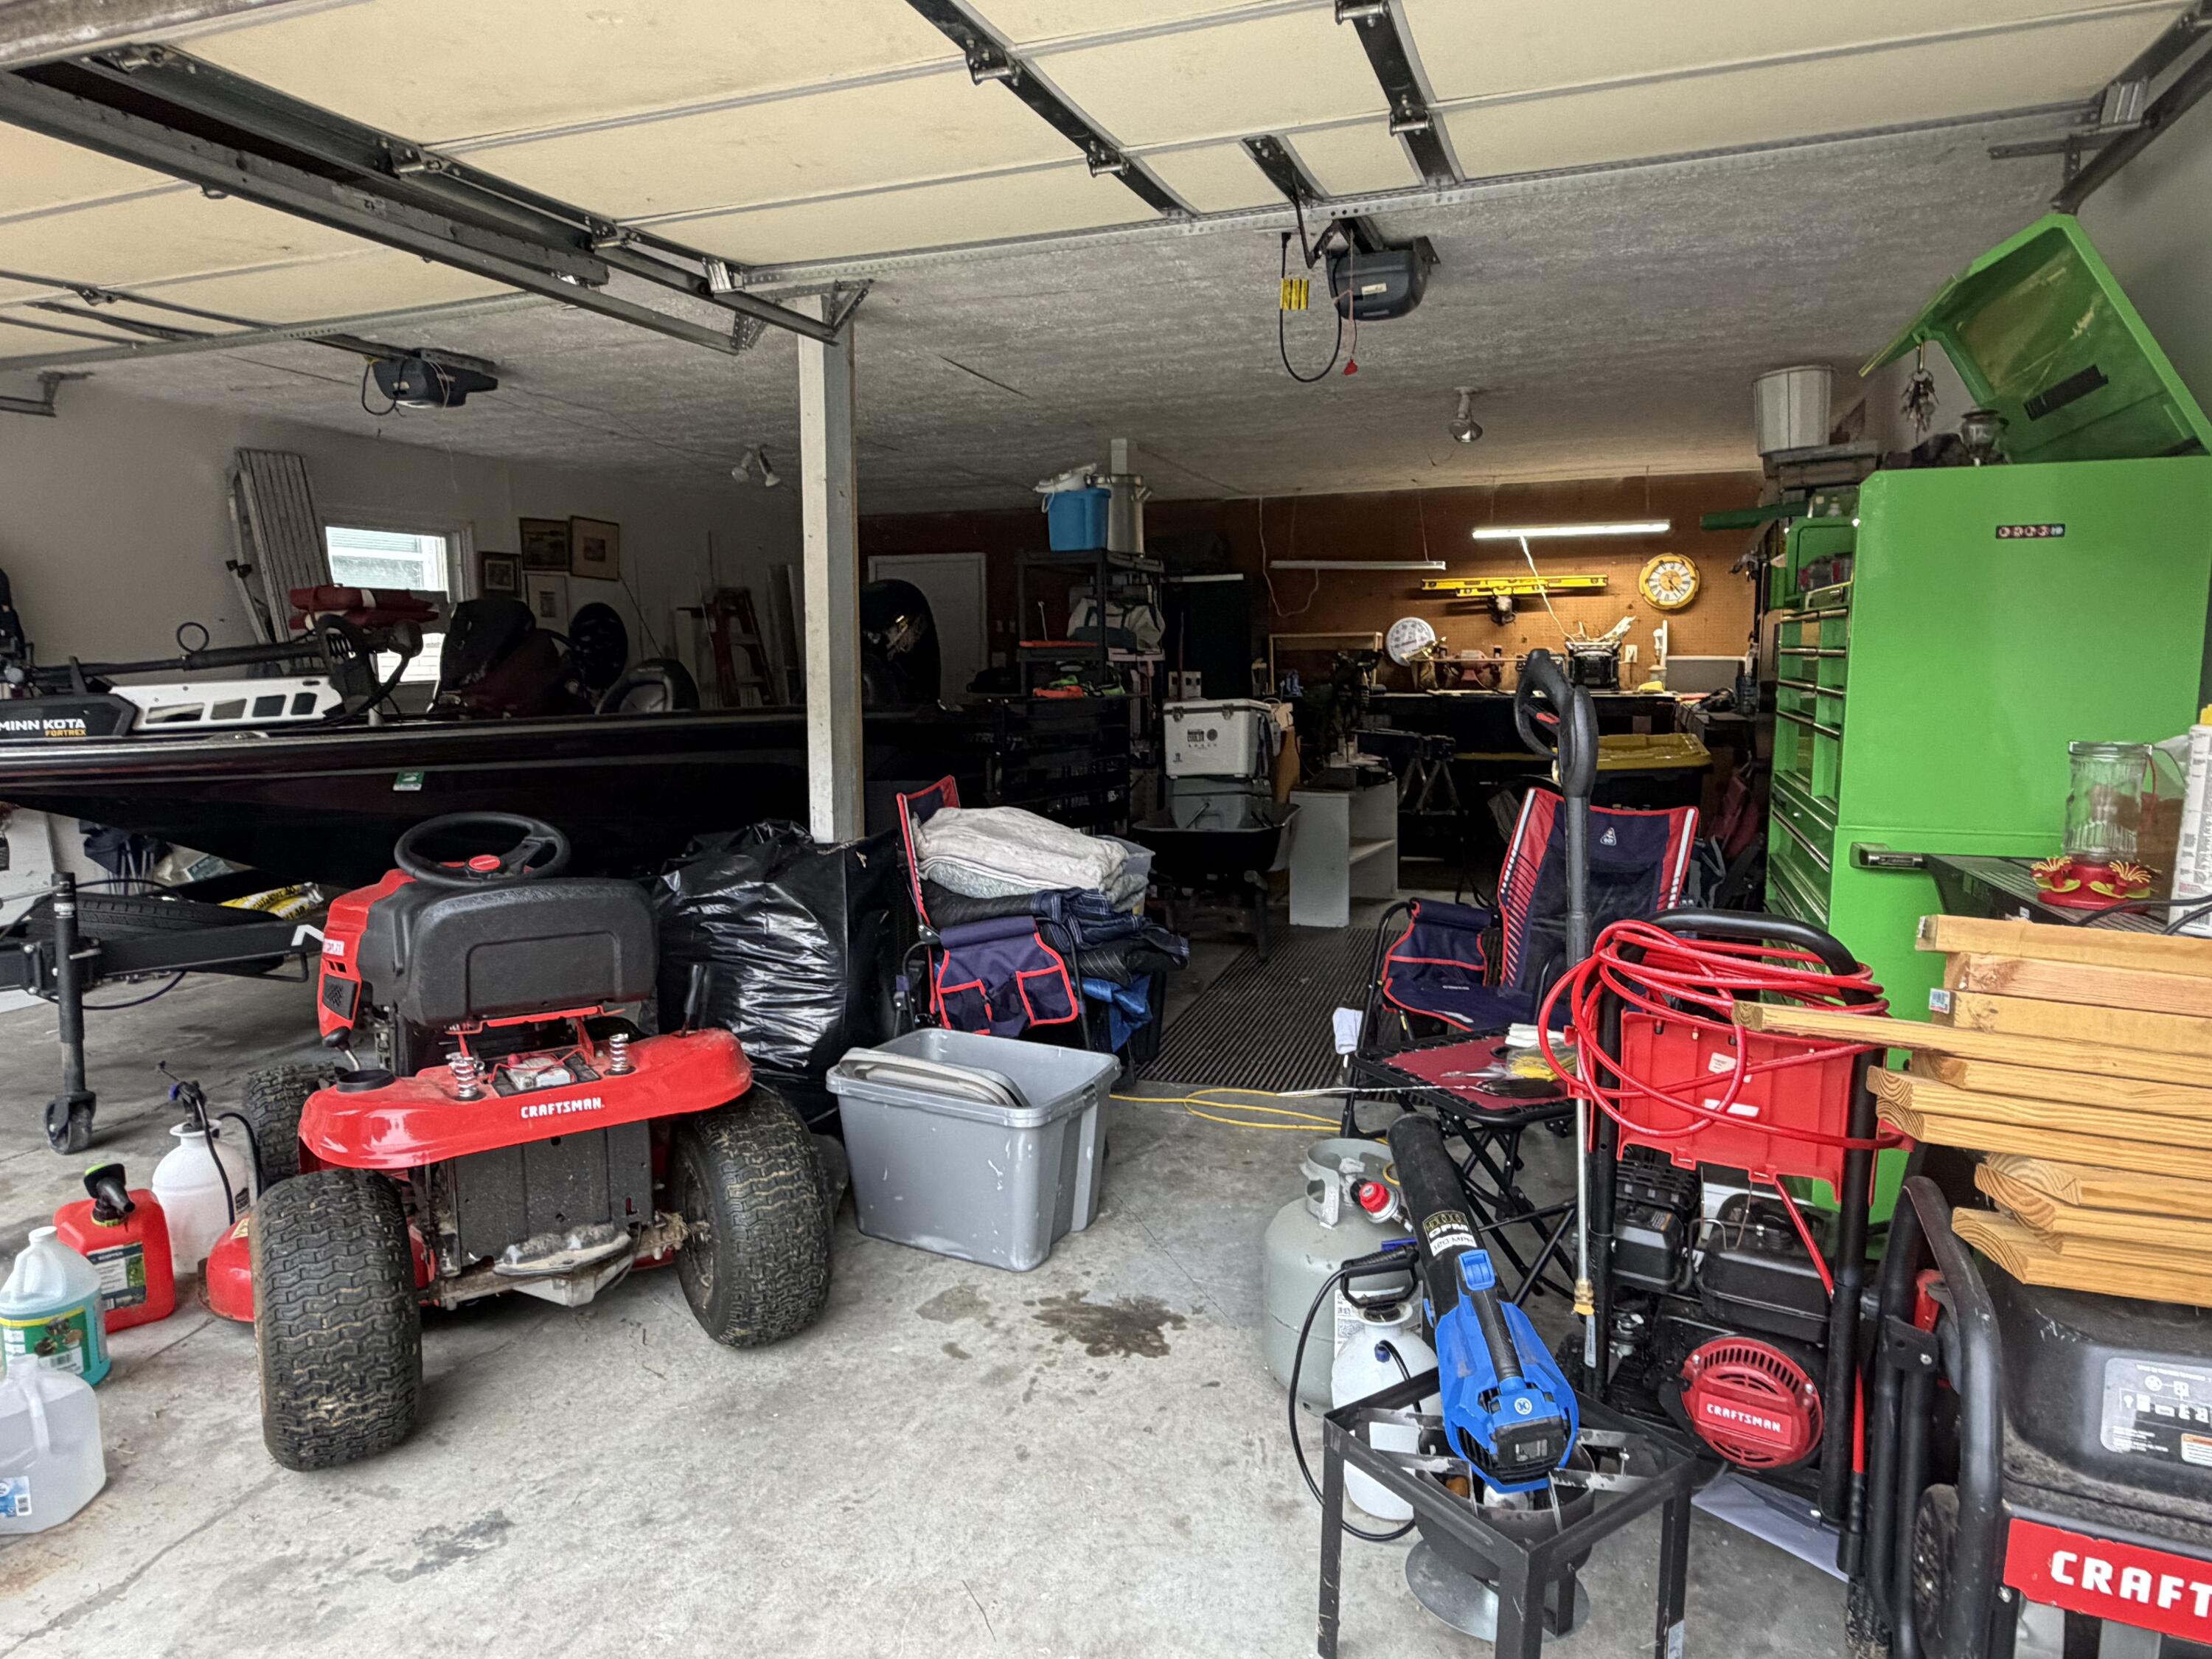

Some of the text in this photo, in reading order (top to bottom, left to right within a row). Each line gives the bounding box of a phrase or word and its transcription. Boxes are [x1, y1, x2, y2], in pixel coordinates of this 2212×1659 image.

[0, 718, 87, 731] MINN KOTA
[45, 728, 87, 737] FORTREX
[521, 1096, 602, 1119] CRAFTSMAN
[1706, 1403, 1781, 1433] CRAFTSMAN
